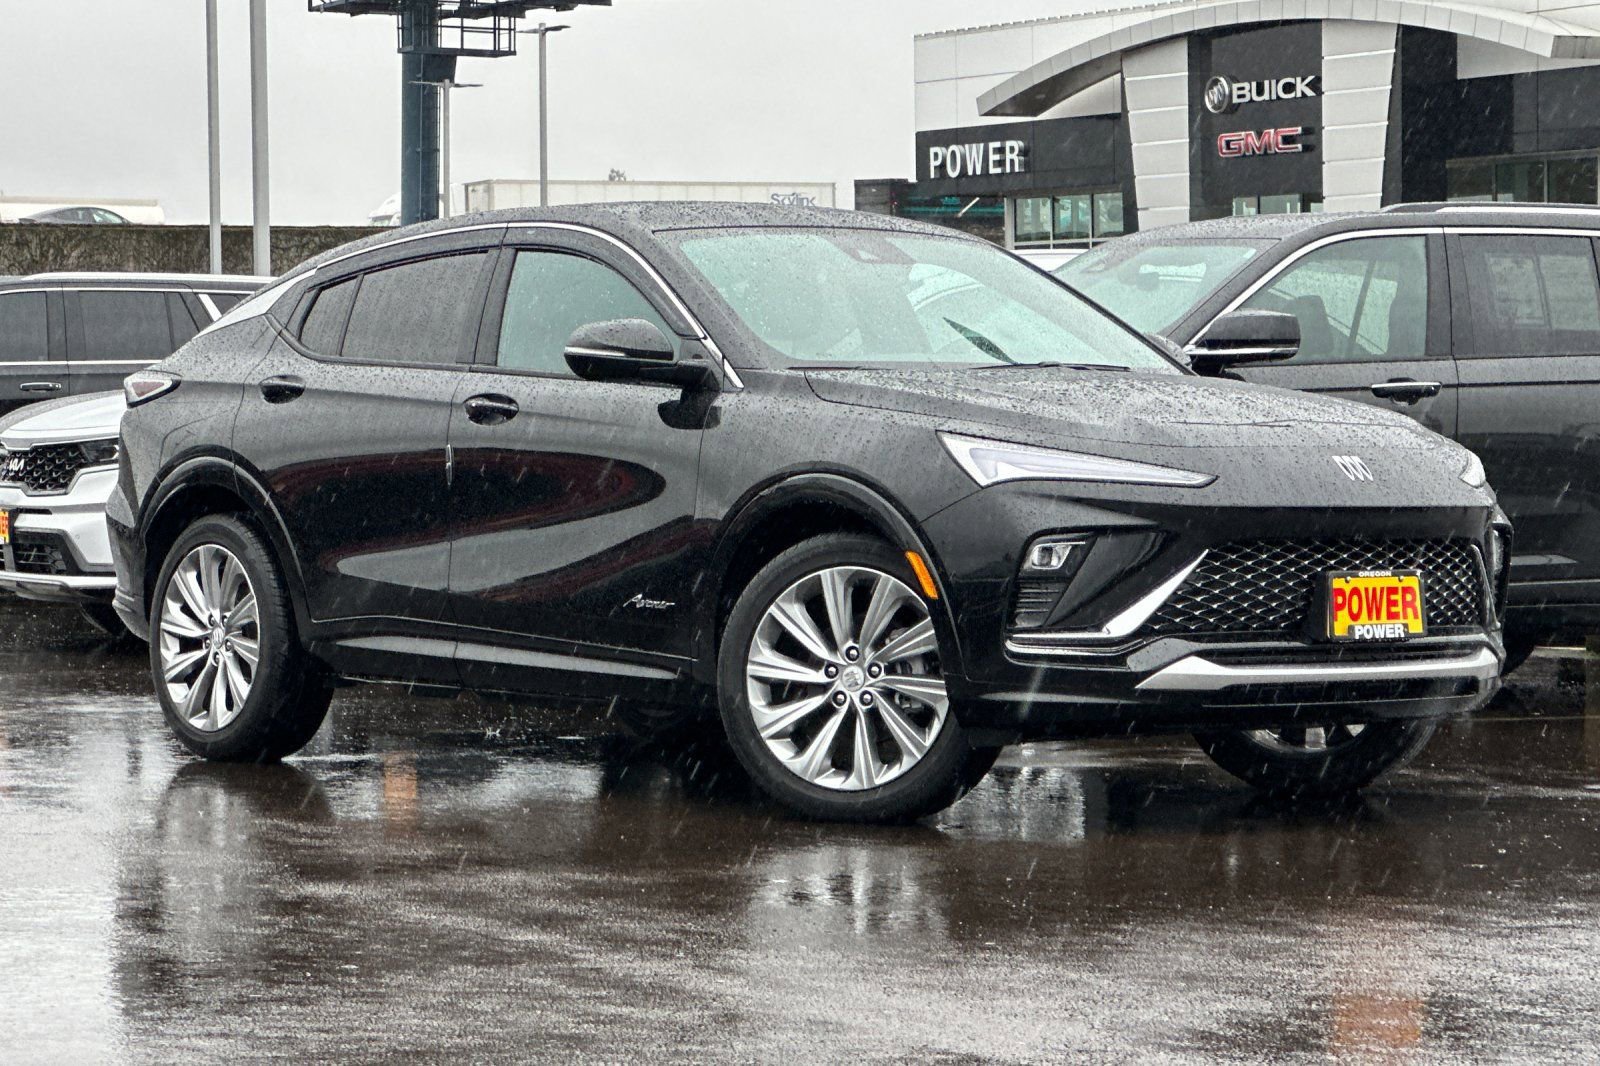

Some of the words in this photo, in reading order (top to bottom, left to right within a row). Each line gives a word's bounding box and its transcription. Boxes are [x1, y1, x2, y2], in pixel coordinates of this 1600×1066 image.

[1231, 75, 1316, 104] BUICK
[1217, 126, 1303, 158] GMC
[929, 140, 1025, 179] POWER
[1333, 586, 1420, 622] POWER
[1354, 623, 1406, 639] POWER
